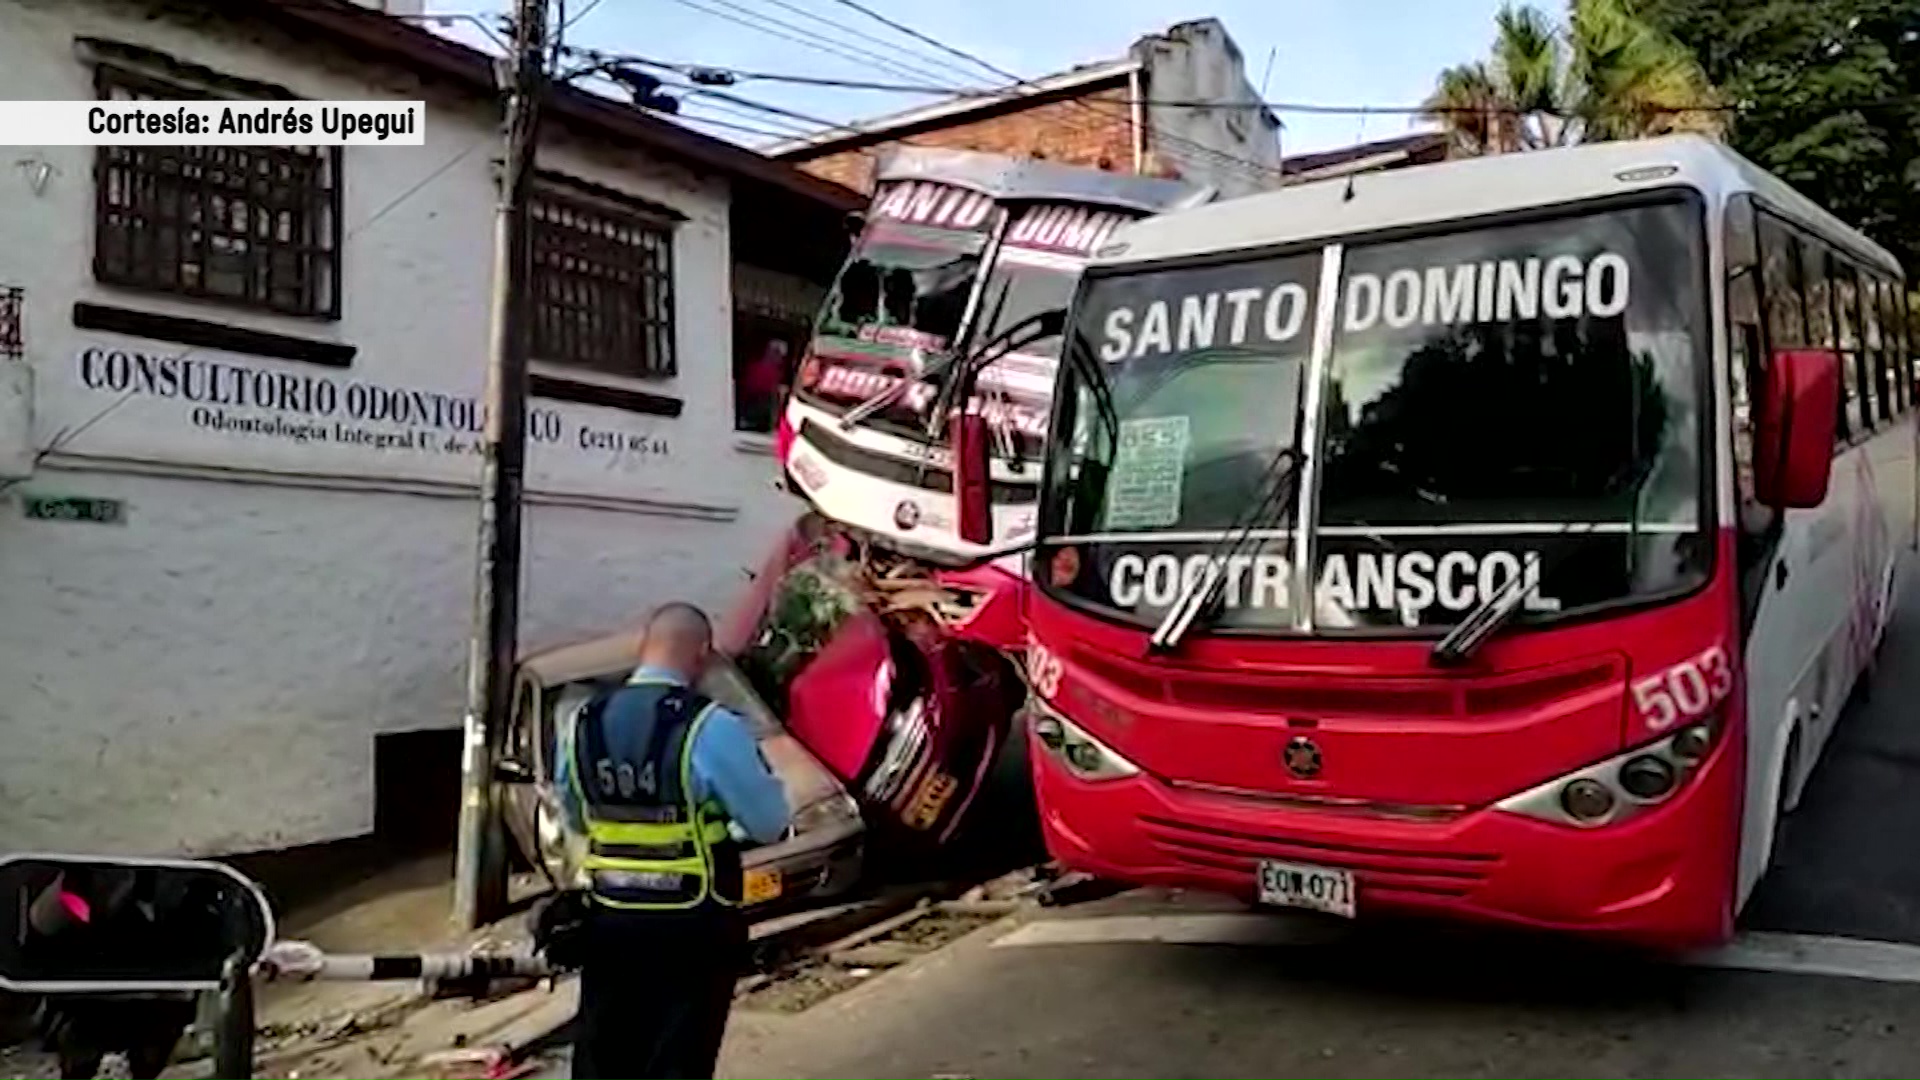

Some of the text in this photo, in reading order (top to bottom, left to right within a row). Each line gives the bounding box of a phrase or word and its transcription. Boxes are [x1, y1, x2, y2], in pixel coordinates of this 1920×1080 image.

[1102, 254, 1630, 362] SANTO DOMINGO
[81, 347, 336, 416] CONSULTORIO
[334, 422, 413, 450] Integral
[1630, 645, 1732, 730] 503
